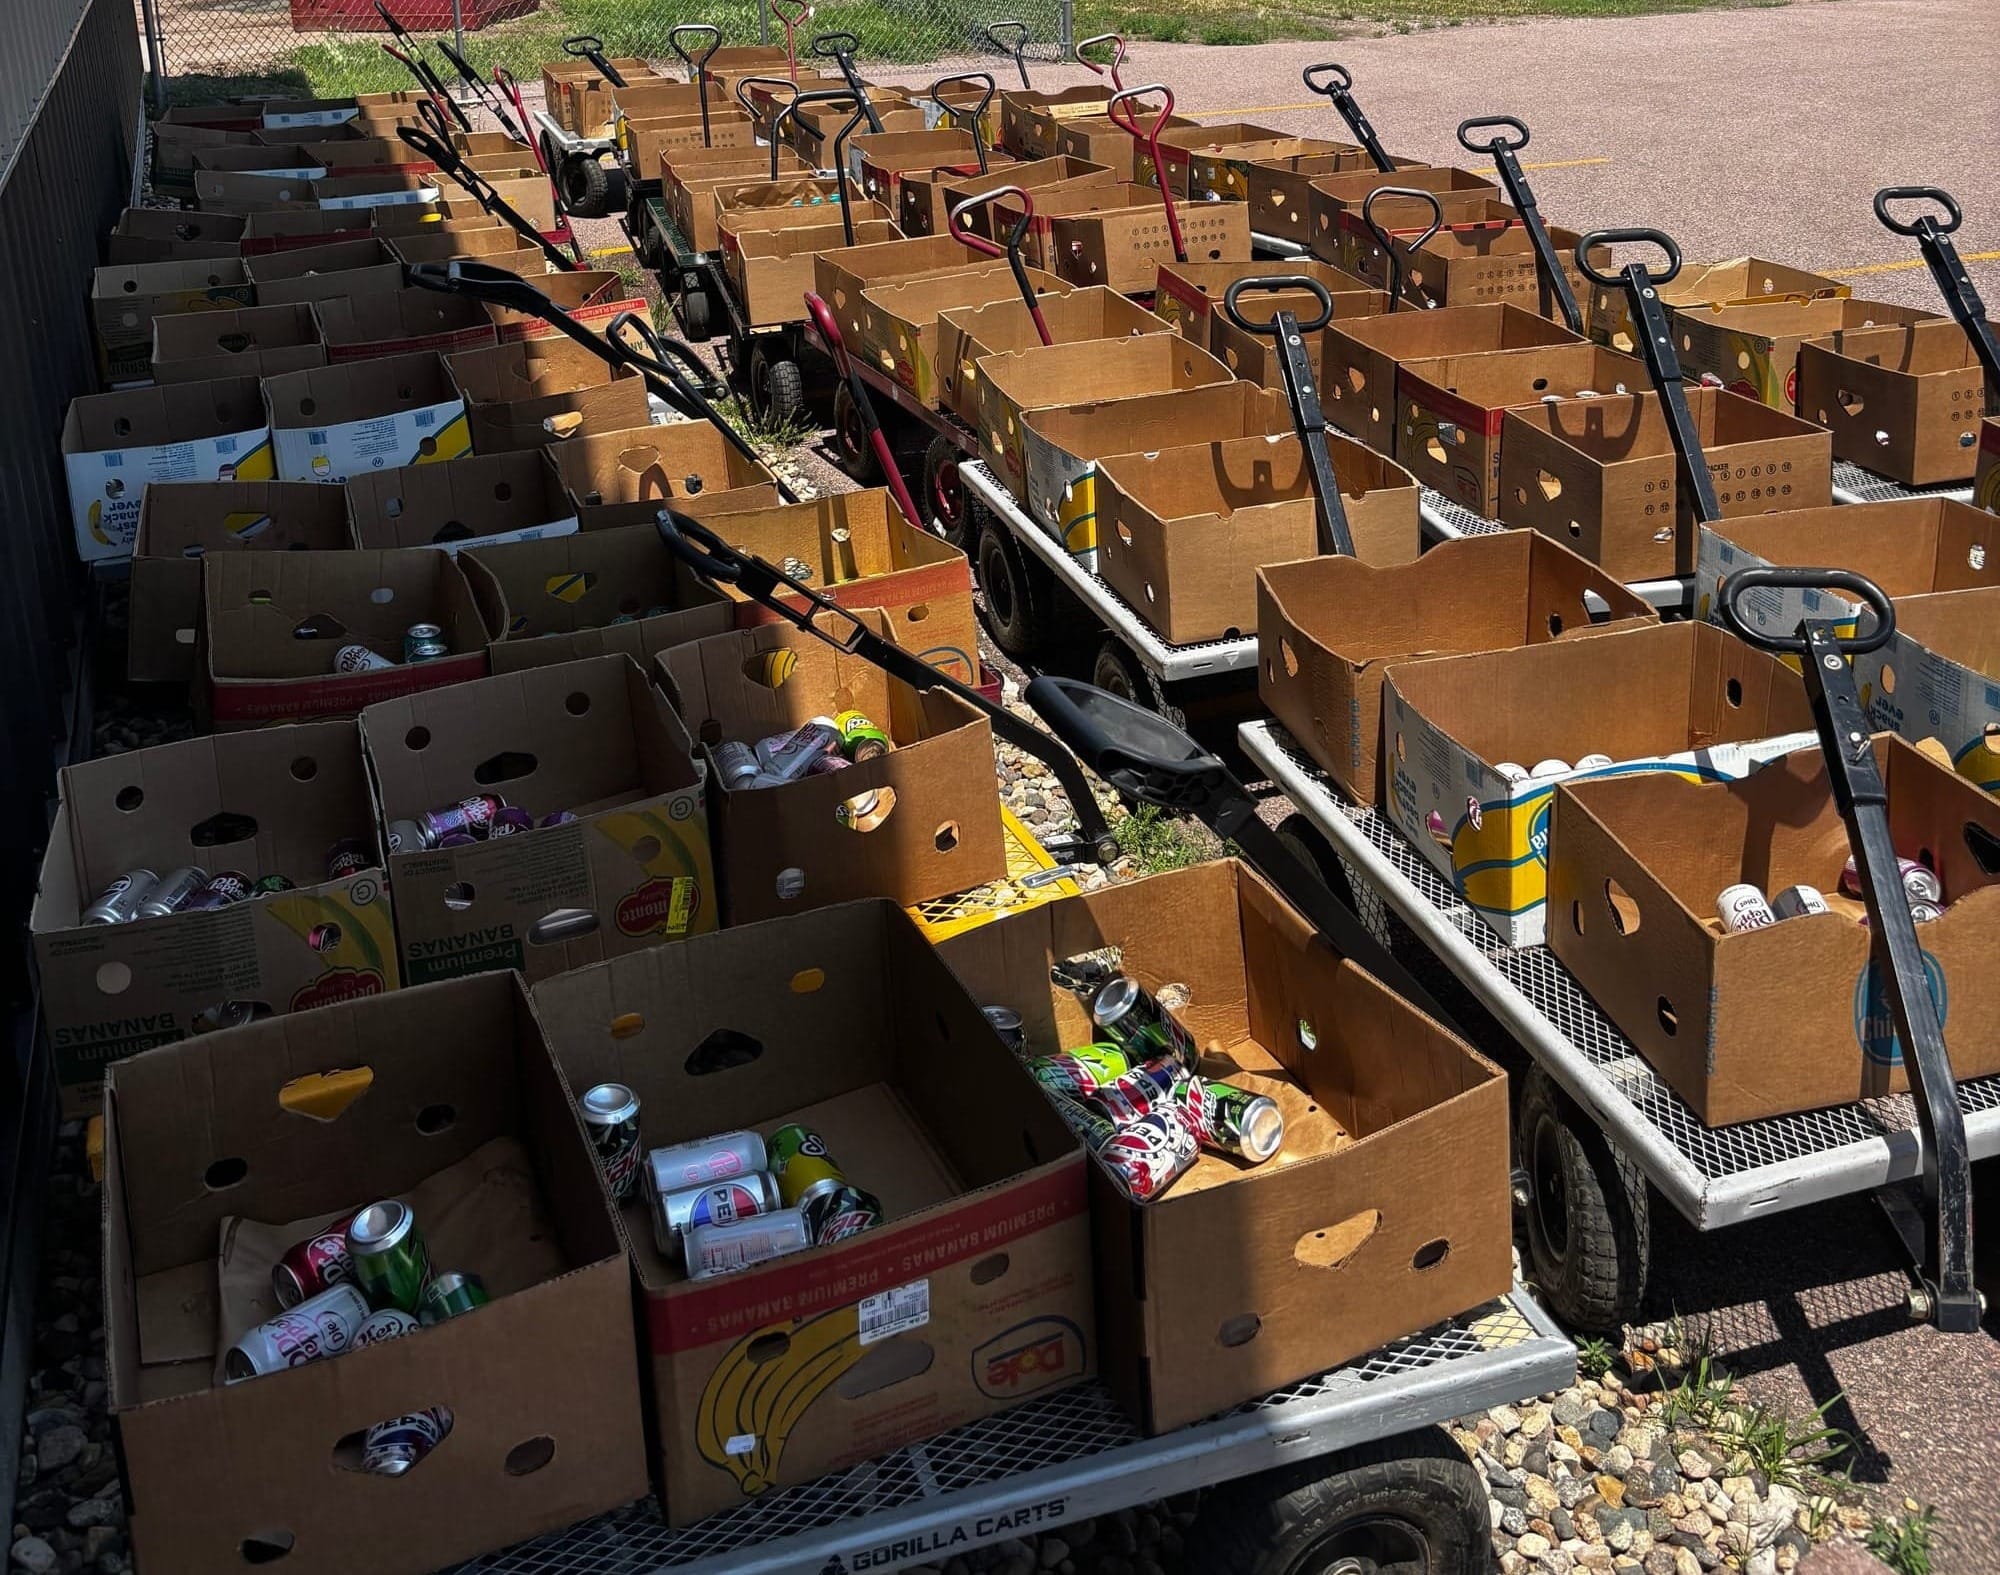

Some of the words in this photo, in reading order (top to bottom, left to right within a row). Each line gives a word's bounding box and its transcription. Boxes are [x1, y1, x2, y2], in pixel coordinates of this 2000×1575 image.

[1707, 463, 1728, 472] ACKER
[117, 521, 137, 532] est
[1739, 898, 1758, 908] Diet
[407, 924, 514, 958] BANANAS
[427, 945, 517, 974] Premium
[55, 1012, 175, 1046] BANANAS
[983, 1201, 1056, 1244] PREMIUM
[902, 1231, 981, 1274] BANANAS
[799, 1268, 878, 1305] PREMIUM
[707, 1296, 793, 1333] BANANAS
[986, 1341, 1064, 1389] Dole
[852, 1526, 968, 1572] GORILLA
[976, 1499, 1066, 1537] CARTS
